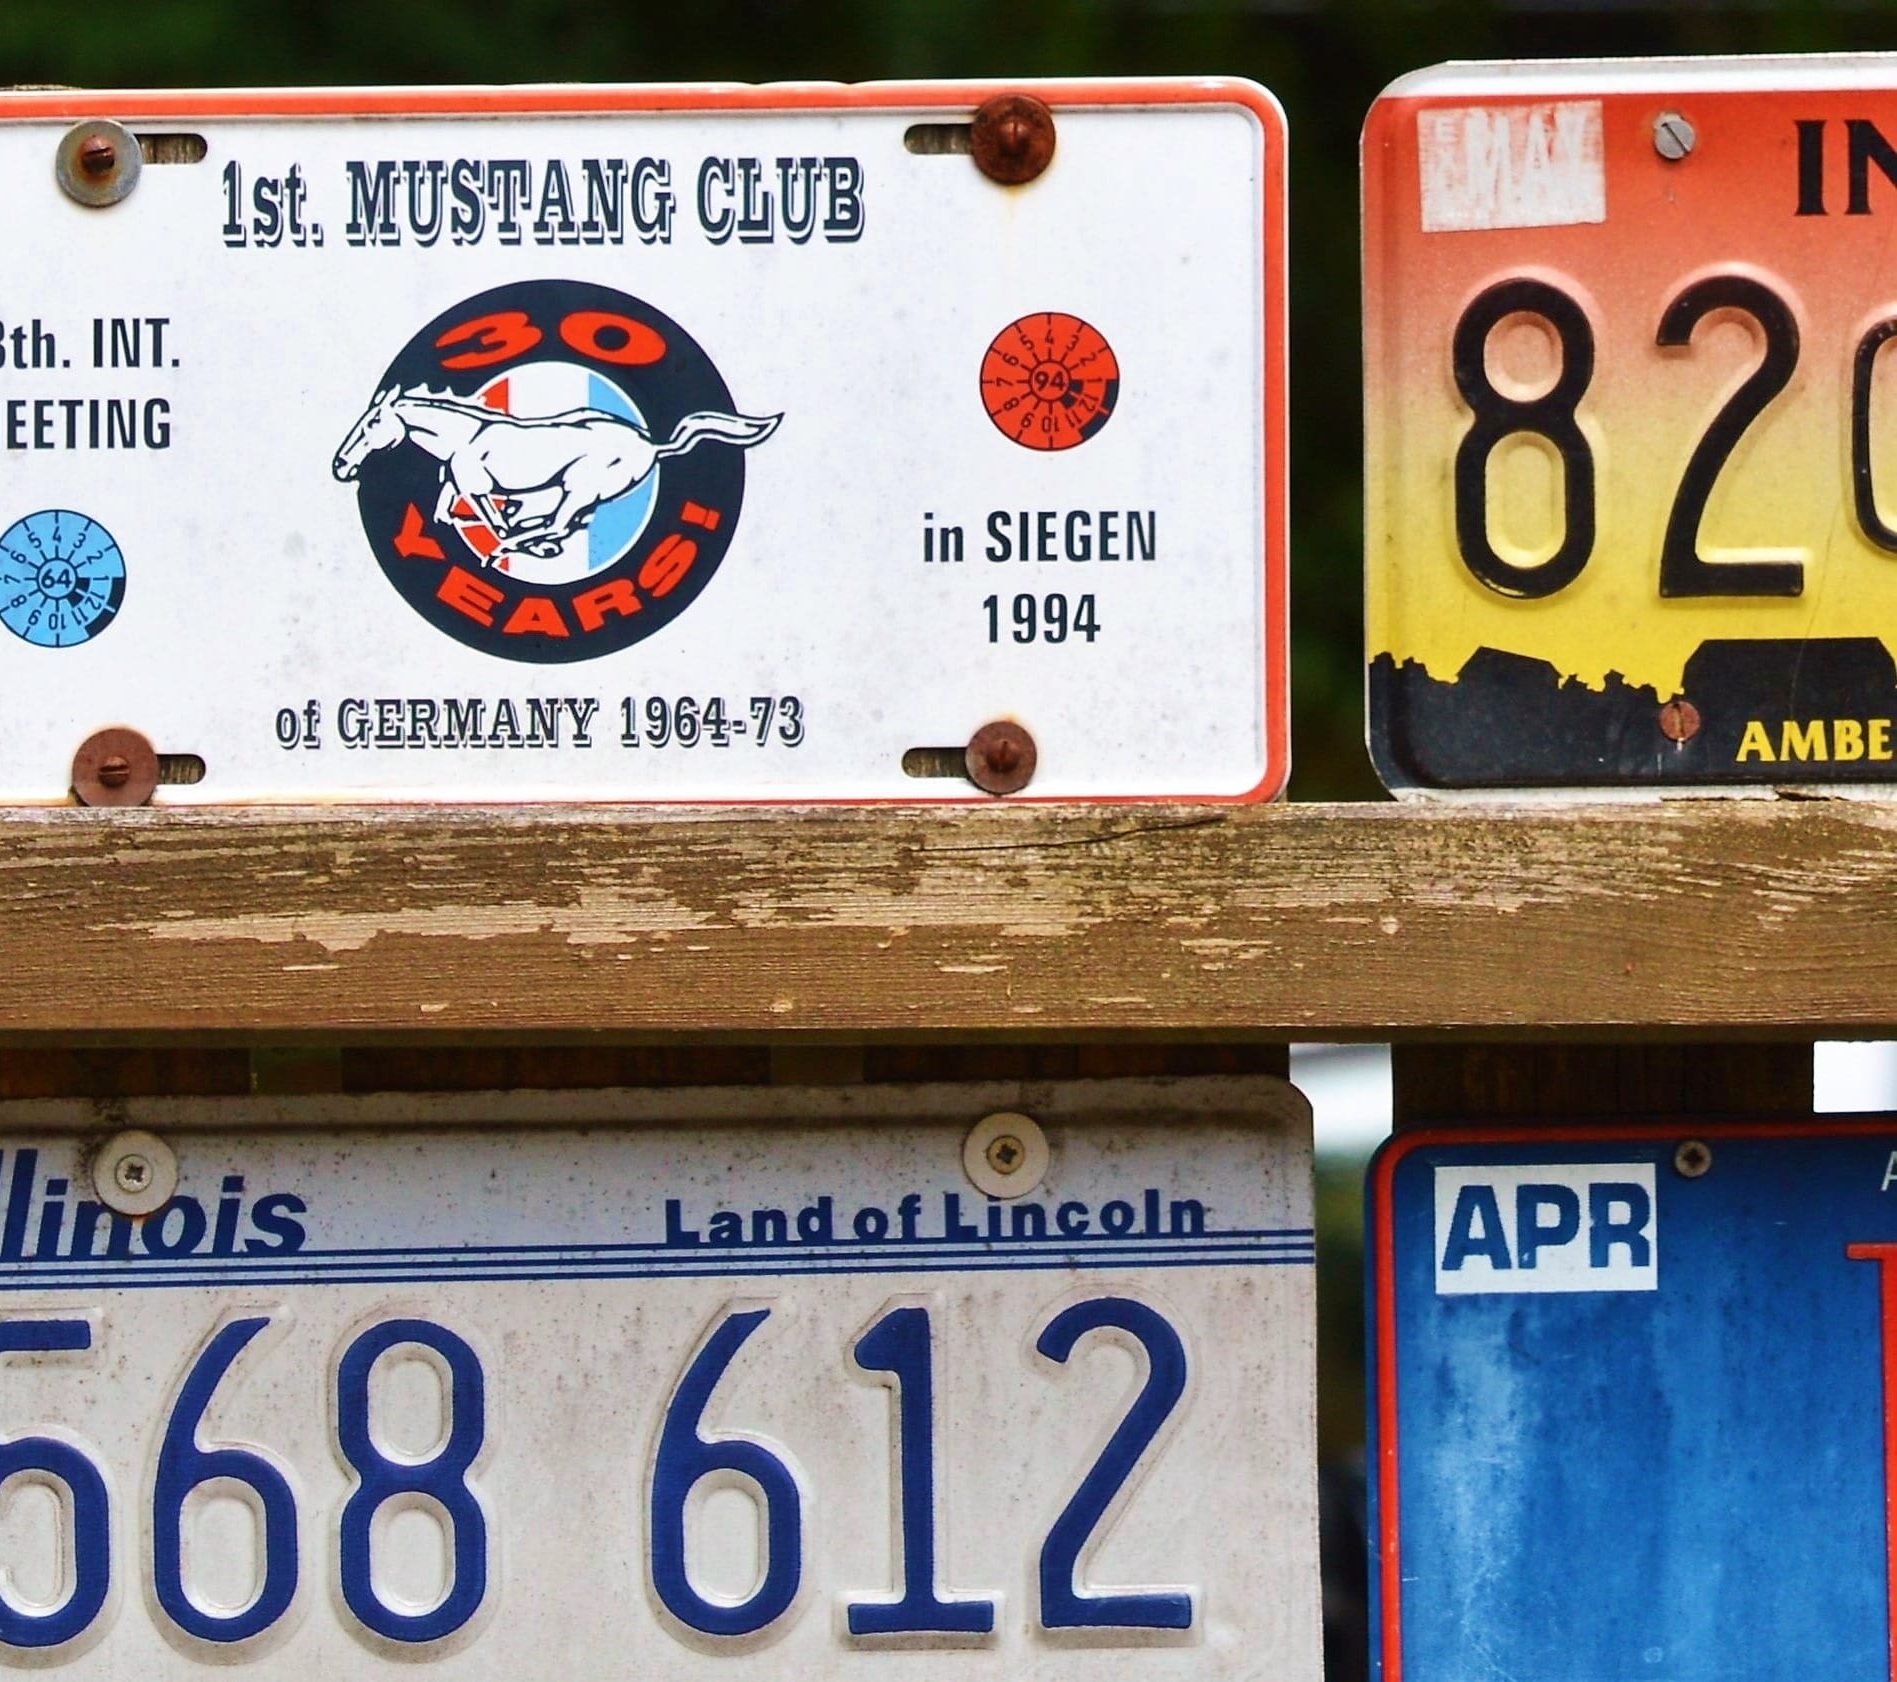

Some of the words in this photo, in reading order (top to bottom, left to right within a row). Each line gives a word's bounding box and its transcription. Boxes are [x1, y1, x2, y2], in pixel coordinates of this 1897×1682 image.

[220, 161, 323, 249] 1st.
[345, 155, 676, 246] MUSTANG
[697, 154, 867, 244] CLUB
[92, 318, 182, 371] INT.
[433, 309, 666, 371] 30
[1034, 370, 1066, 392] 94
[922, 511, 966, 564] in
[982, 510, 1158, 564] SIEGEN
[40, 568, 72, 589] 64
[388, 500, 725, 640] YEARS!
[982, 594, 1102, 645] 1994
[275, 699, 323, 751] of
[337, 698, 598, 751] GERMANY
[617, 697, 805, 748] 1964-73
[665, 1196, 833, 1246] Land
[853, 1194, 922, 1241] of
[944, 1189, 1206, 1240] Lincoln
[1440, 1182, 1651, 1271] APR
[649, 1296, 1194, 1640] 612
